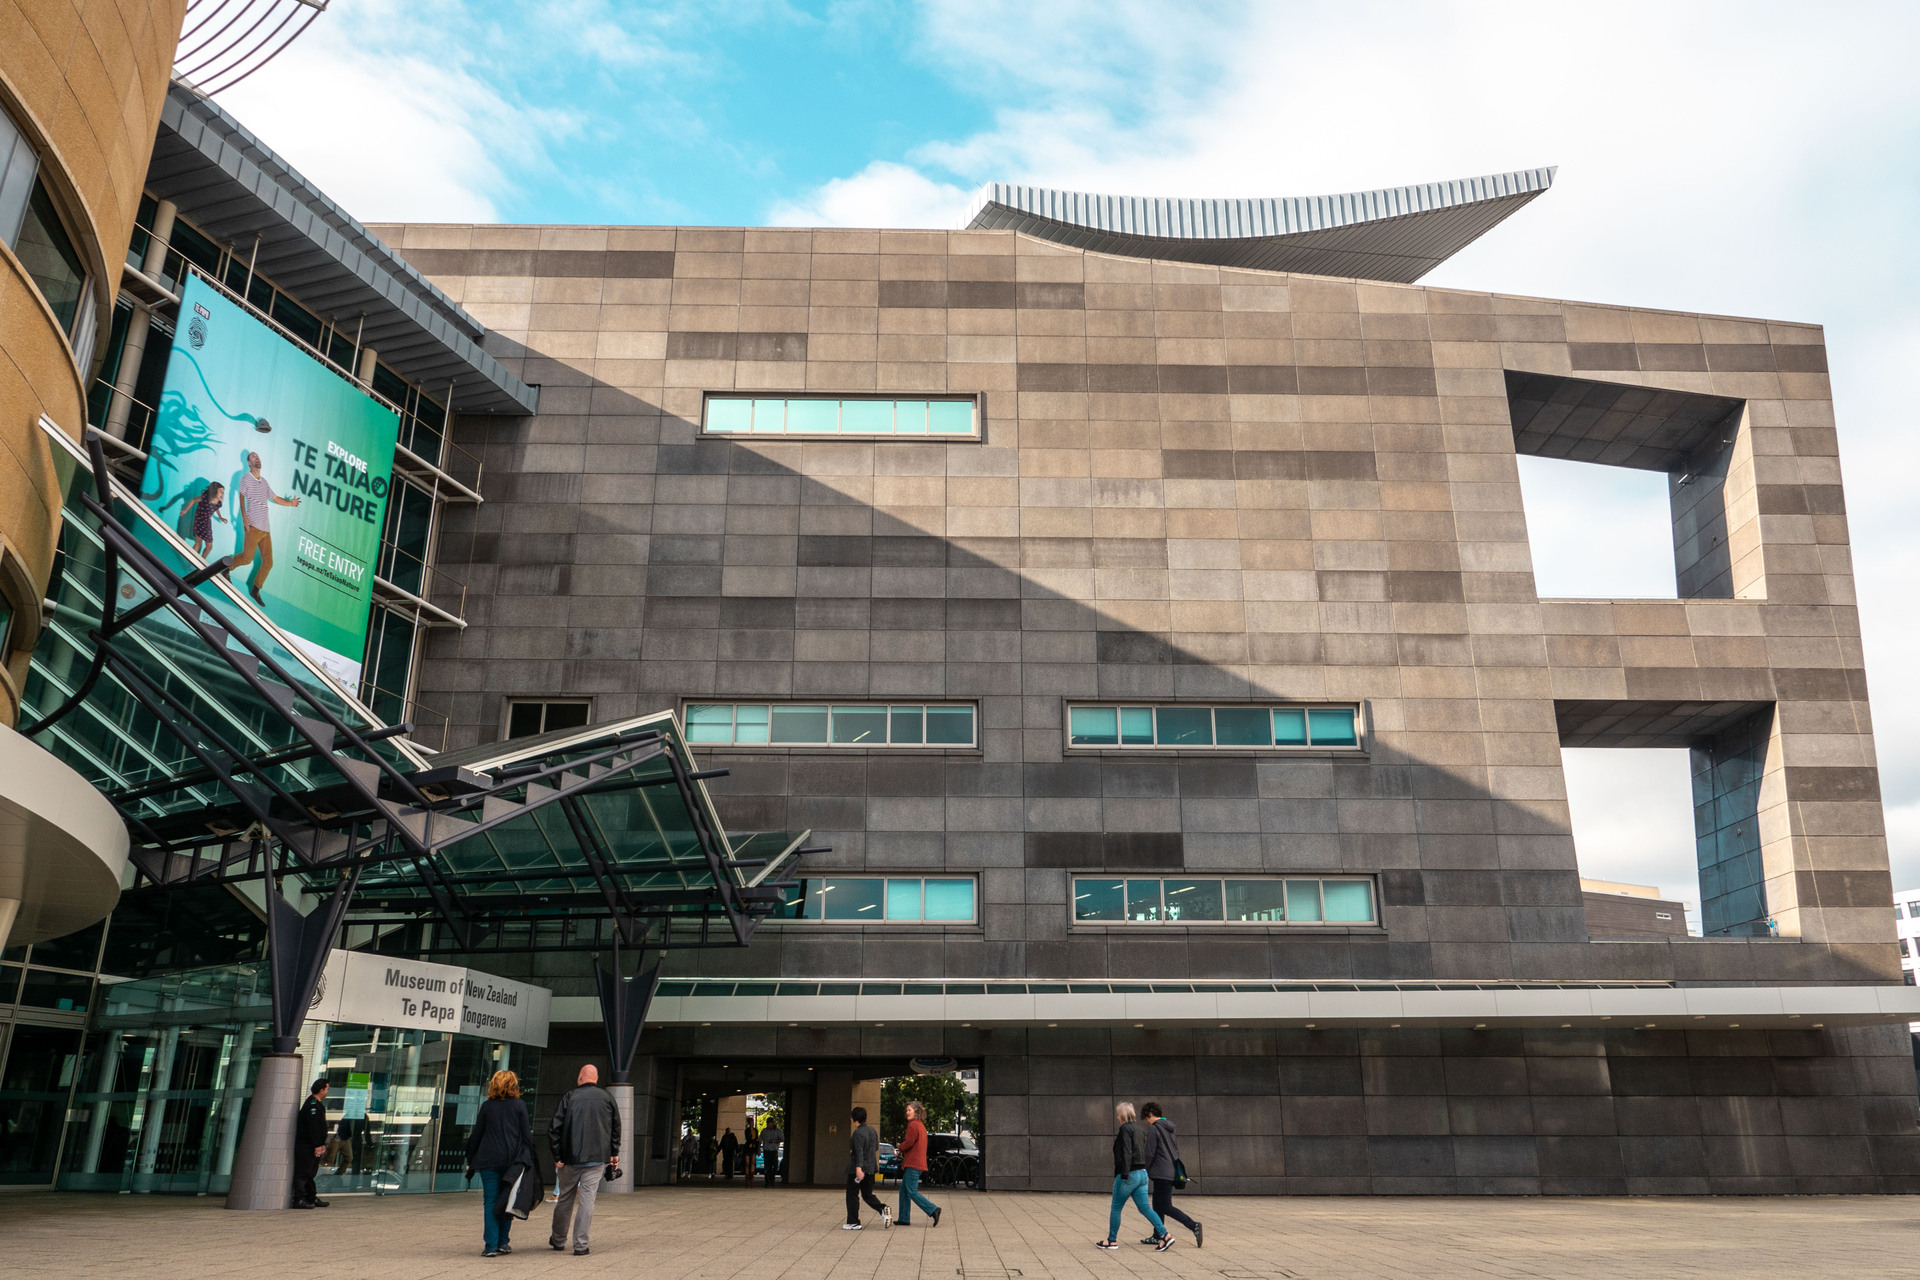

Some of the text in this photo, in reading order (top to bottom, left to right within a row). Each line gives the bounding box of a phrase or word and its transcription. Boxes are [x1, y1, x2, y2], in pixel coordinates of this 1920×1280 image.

[292, 438, 388, 499] TE TAIAO
[327, 440, 368, 474] EXPLORE
[291, 468, 378, 525] NATURE
[298, 535, 365, 582] FREE ENTRY
[384, 968, 518, 1007] Museum of New Zealand
[401, 997, 507, 1029] Te Papa Tongarewa
